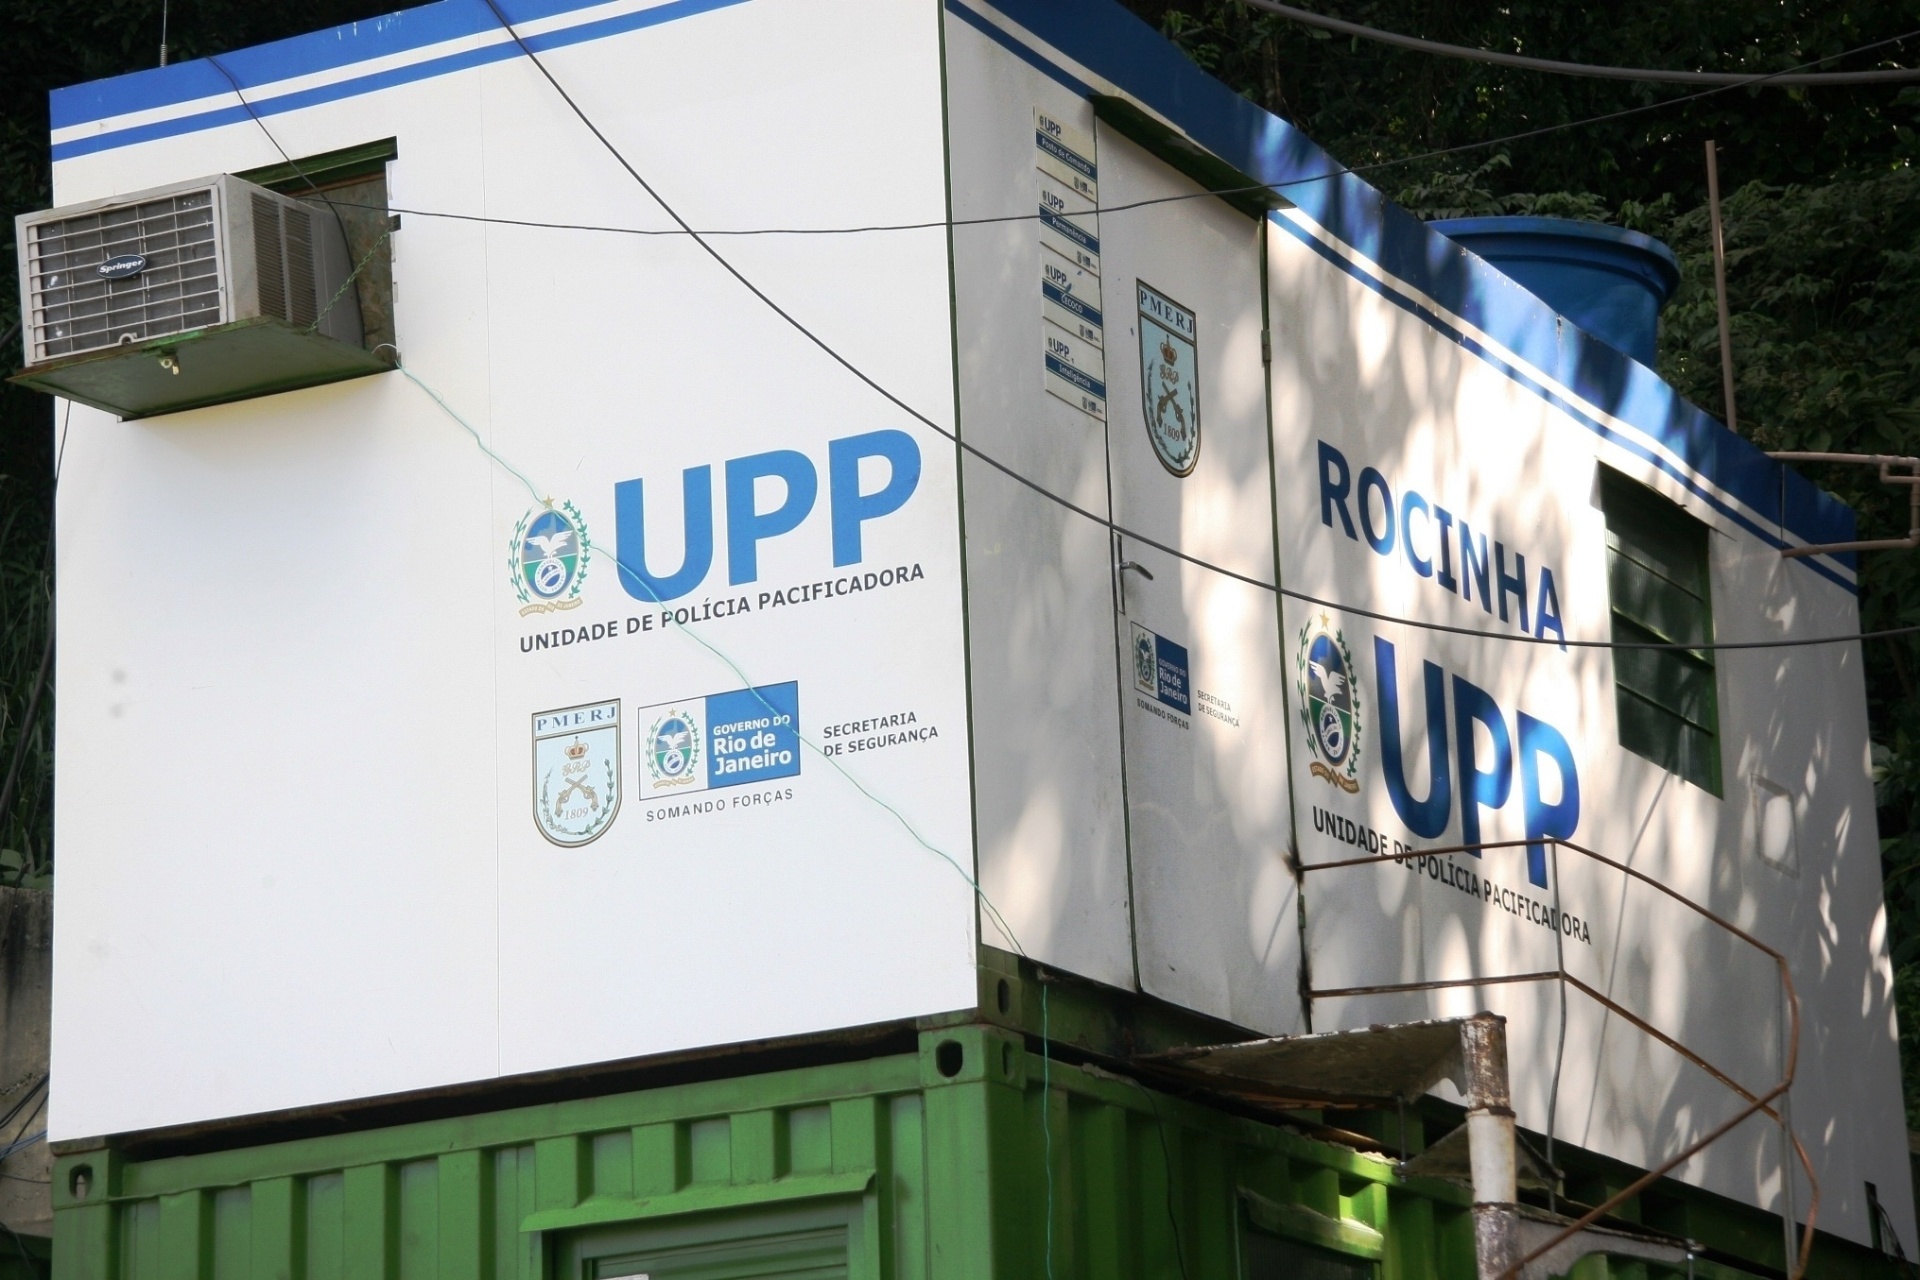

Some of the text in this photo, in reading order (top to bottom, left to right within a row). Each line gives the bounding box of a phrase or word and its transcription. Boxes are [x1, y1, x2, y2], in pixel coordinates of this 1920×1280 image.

[1044, 116, 1061, 137] UPP
[1048, 192, 1064, 211] UPP
[99, 260, 143, 273] Springer
[1050, 265, 1066, 284] UPP
[1139, 290, 1193, 334] PMERJ
[1053, 338, 1070, 357] UPP
[1163, 422, 1181, 442] 1809
[614, 428, 922, 603] UPP
[1317, 438, 1568, 653] ROCINHA
[520, 563, 924, 653] UNIDADE DE POLÍCIA PACIFICADORA
[1160, 667, 1171, 683] Rio
[1172, 674, 1181, 688] de
[1160, 681, 1188, 704] Janeiro
[1197, 690, 1232, 712] SECRETARIA
[536, 706, 616, 732] PMERJ
[713, 714, 791, 736] GOVERNO DO
[823, 711, 917, 738] SECRETARIA
[1137, 698, 1189, 730] SOMANDO FORÇAS
[714, 730, 776, 756] Rio de
[824, 726, 939, 757] DE SEGURANÇA
[714, 749, 792, 776] Janeiro
[1373, 635, 1580, 890] UPP
[564, 807, 588, 820] 1809
[646, 788, 793, 822] SOMANDO FORÇAS
[1312, 806, 1388, 856] UNIDADE
[1394, 840, 1413, 870] DE
[1417, 854, 1481, 898] POLÍCIA
